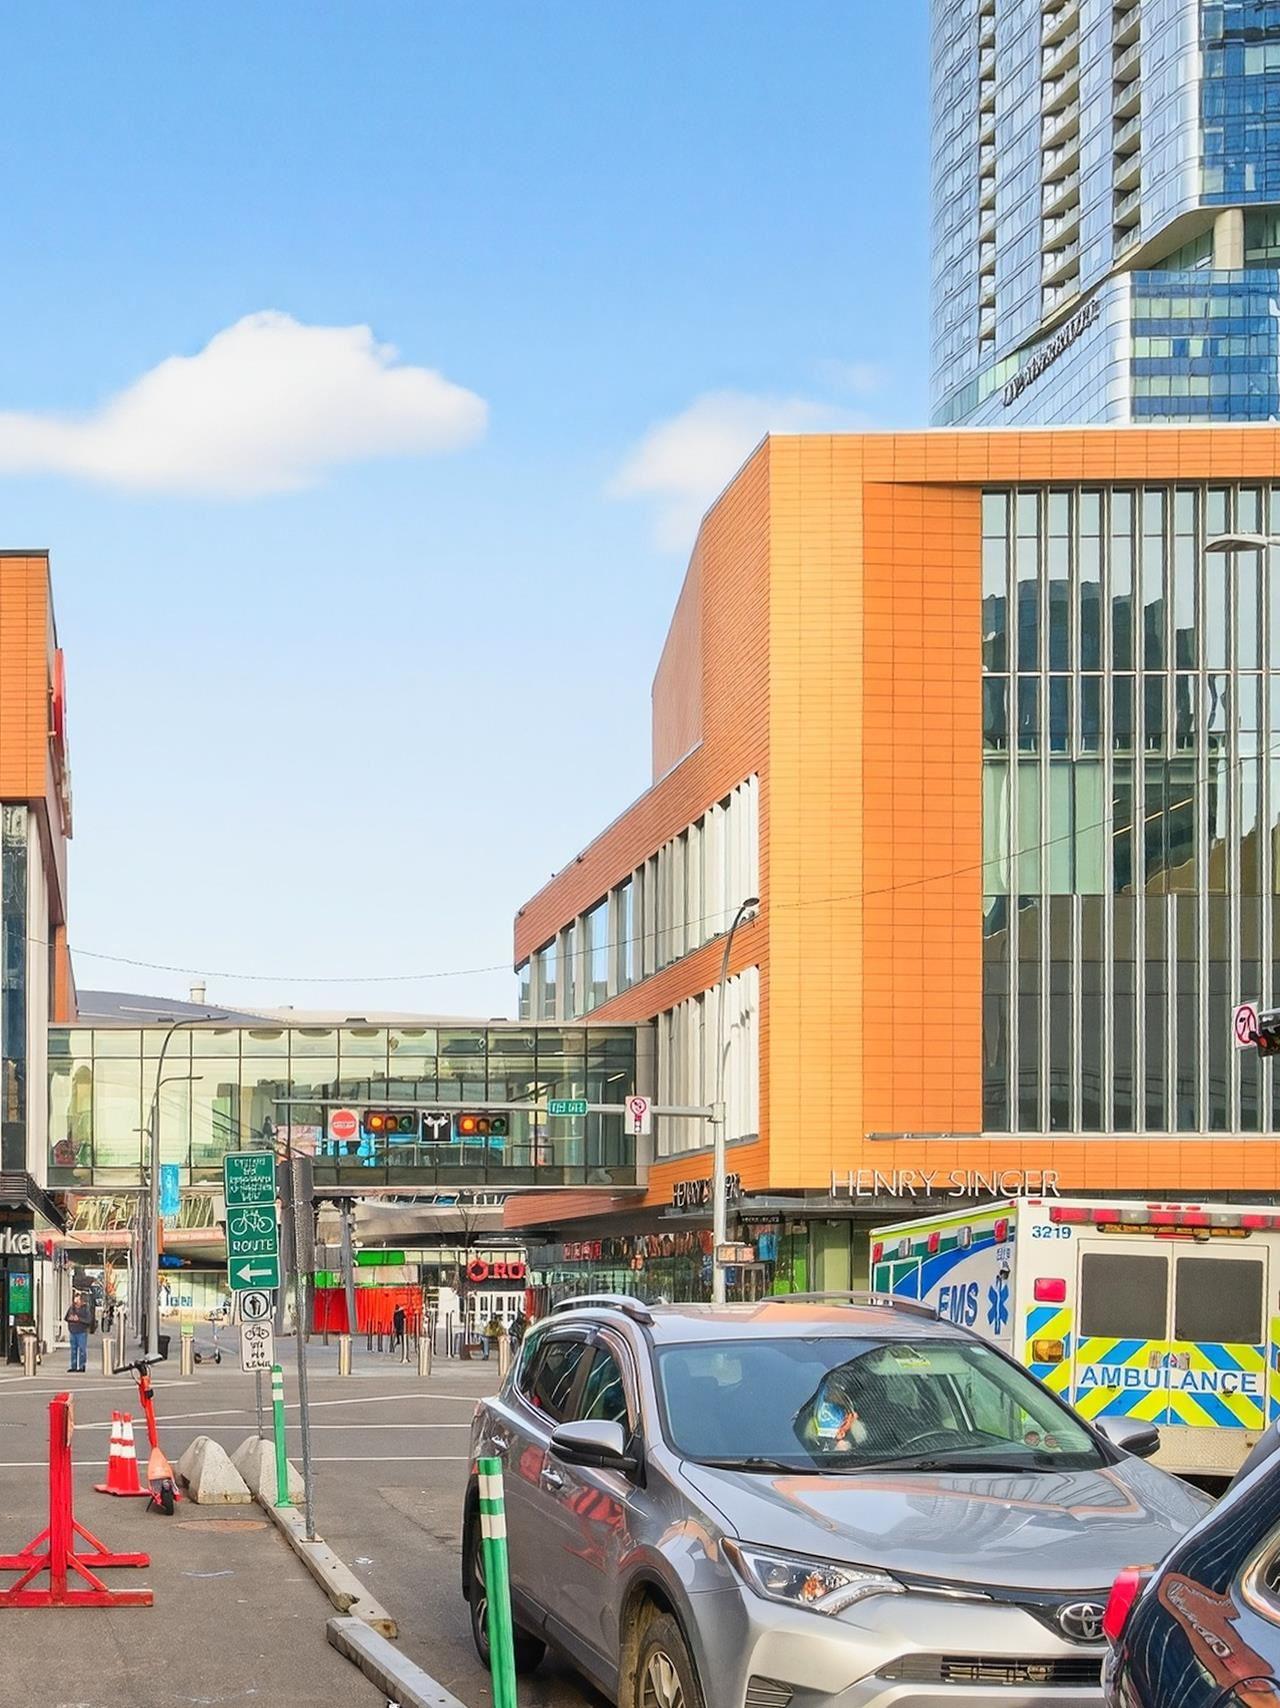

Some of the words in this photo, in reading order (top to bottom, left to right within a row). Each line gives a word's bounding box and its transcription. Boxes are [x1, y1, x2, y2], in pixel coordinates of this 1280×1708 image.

[830, 1169, 939, 1198] HENRY
[948, 1169, 1061, 1198] SINGER
[233, 1239, 273, 1252] ROUTE
[1031, 1226, 1072, 1240] 3219
[937, 1281, 979, 1326] EMS
[1080, 1366, 1257, 1393] AMBULANCE
